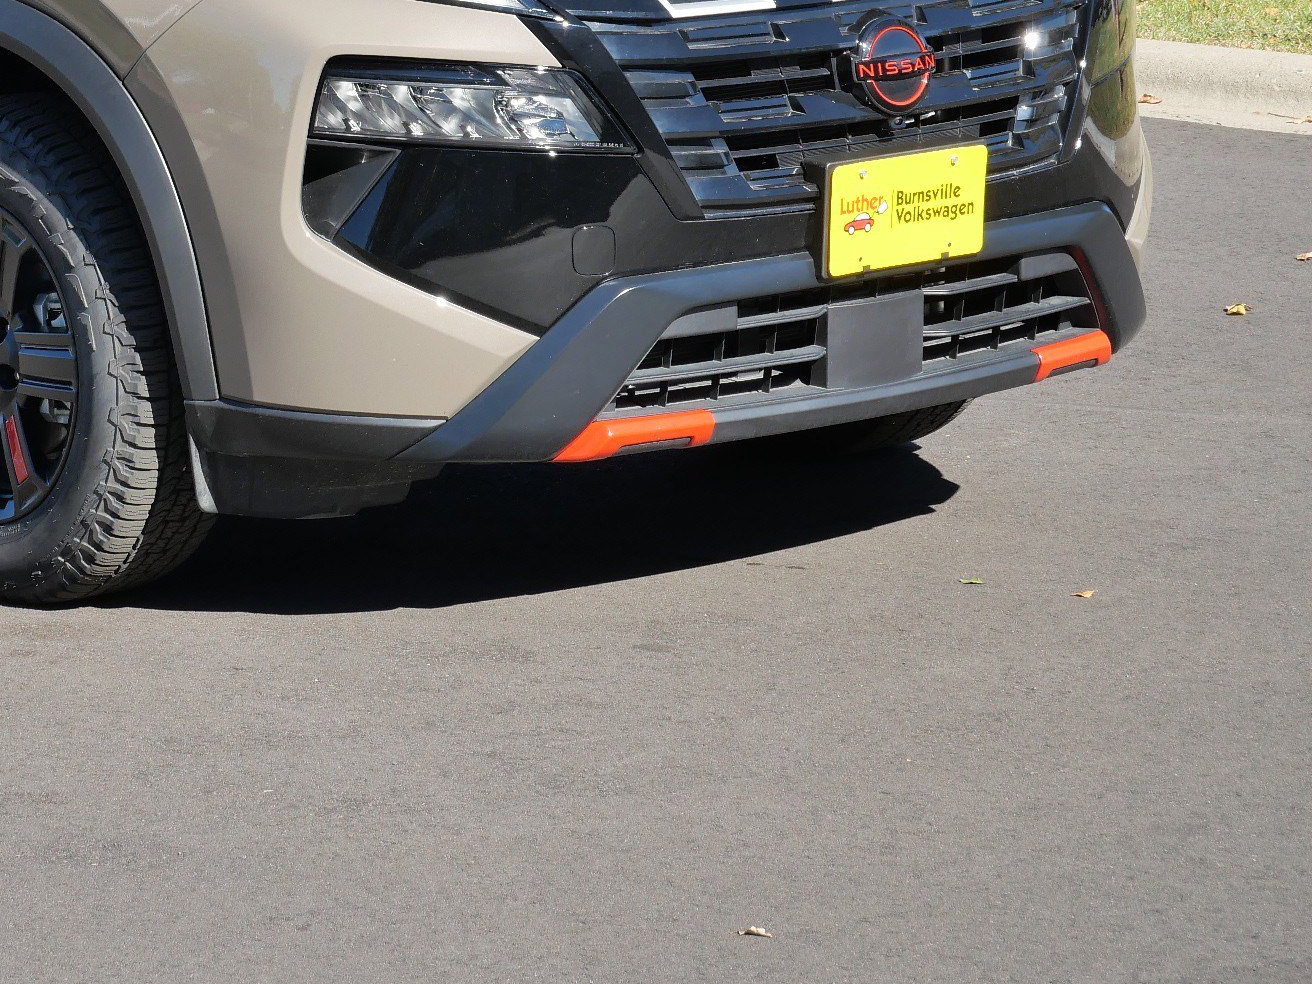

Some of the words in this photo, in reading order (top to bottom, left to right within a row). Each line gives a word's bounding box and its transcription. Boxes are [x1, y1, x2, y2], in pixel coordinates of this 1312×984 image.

[858, 54, 936, 78] NISSAN
[840, 194, 885, 215] Luther
[896, 182, 961, 206] Burnsville
[895, 201, 975, 224] Volkswagen
